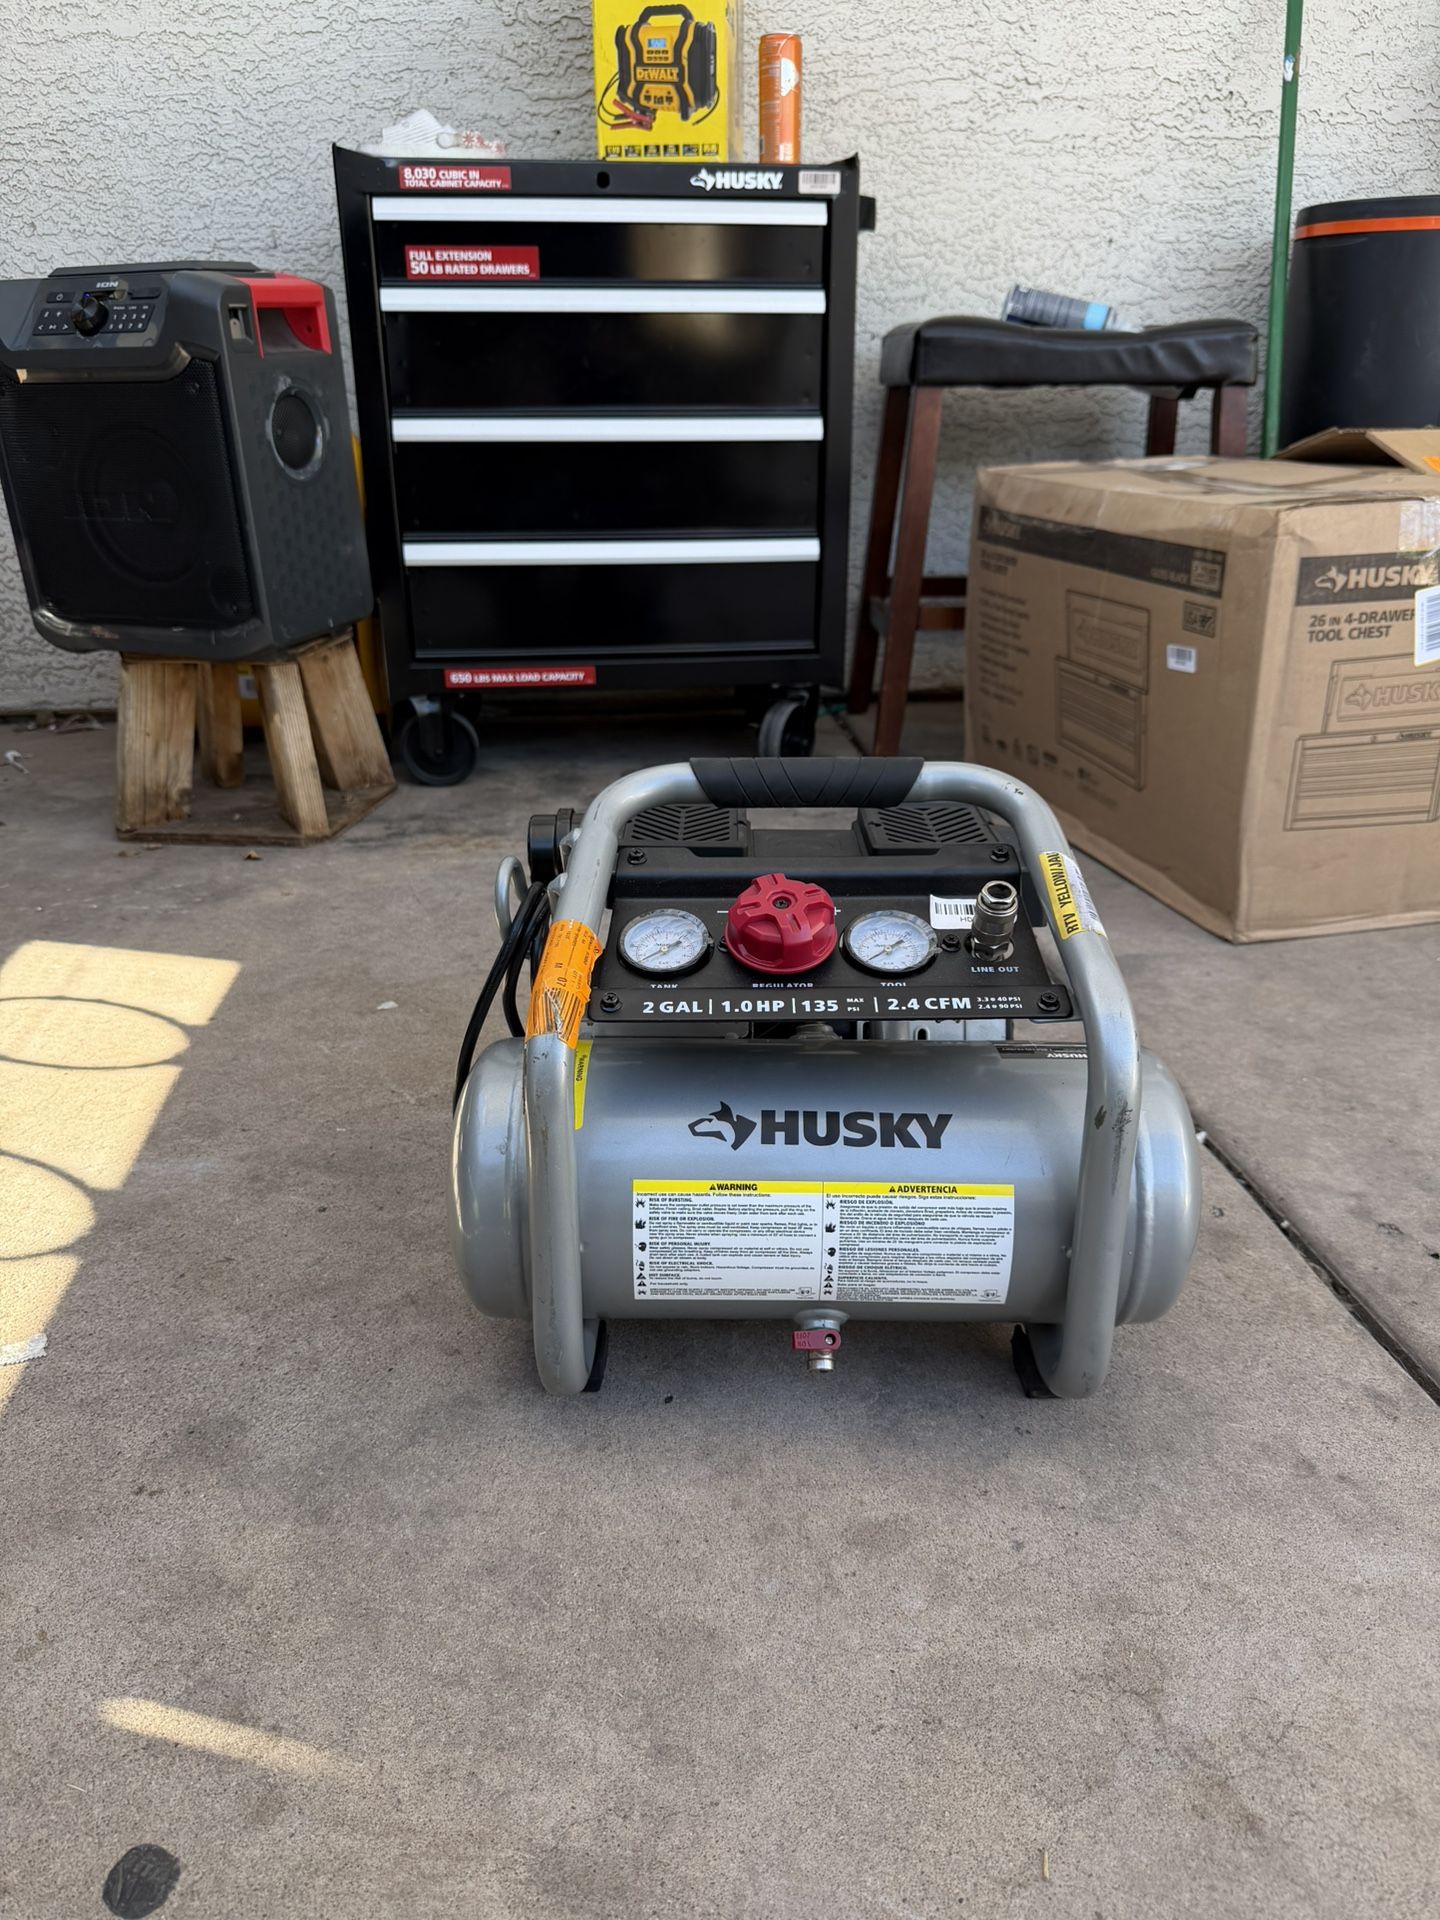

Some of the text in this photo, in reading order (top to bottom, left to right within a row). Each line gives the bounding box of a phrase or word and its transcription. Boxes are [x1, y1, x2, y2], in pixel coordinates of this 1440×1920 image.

[404, 168, 479, 180] 8,030 CUBIC IN
[716, 171, 783, 190] HUSKY
[404, 180, 501, 188] TOTAL CABINET CAPACITY
[409, 251, 492, 261] FULL EXTENSION
[411, 262, 530, 275] 50 LB RATED DRAWERS
[1347, 564, 1436, 589] HUSKY
[1308, 615, 1326, 627] 26
[1328, 616, 1340, 626] IN
[1308, 625, 1392, 642] TOOL CHEST
[492, 673, 514, 683] MAX
[517, 672, 540, 682] LOAD
[542, 672, 585, 682] CAPACITY
[1063, 912, 1080, 934] RTV
[643, 1000, 838, 1014] 2 GAL 1.0 HP 135
[888, 997, 971, 1010] 2.4 CFM
[761, 1110, 953, 1149] HUSKY
